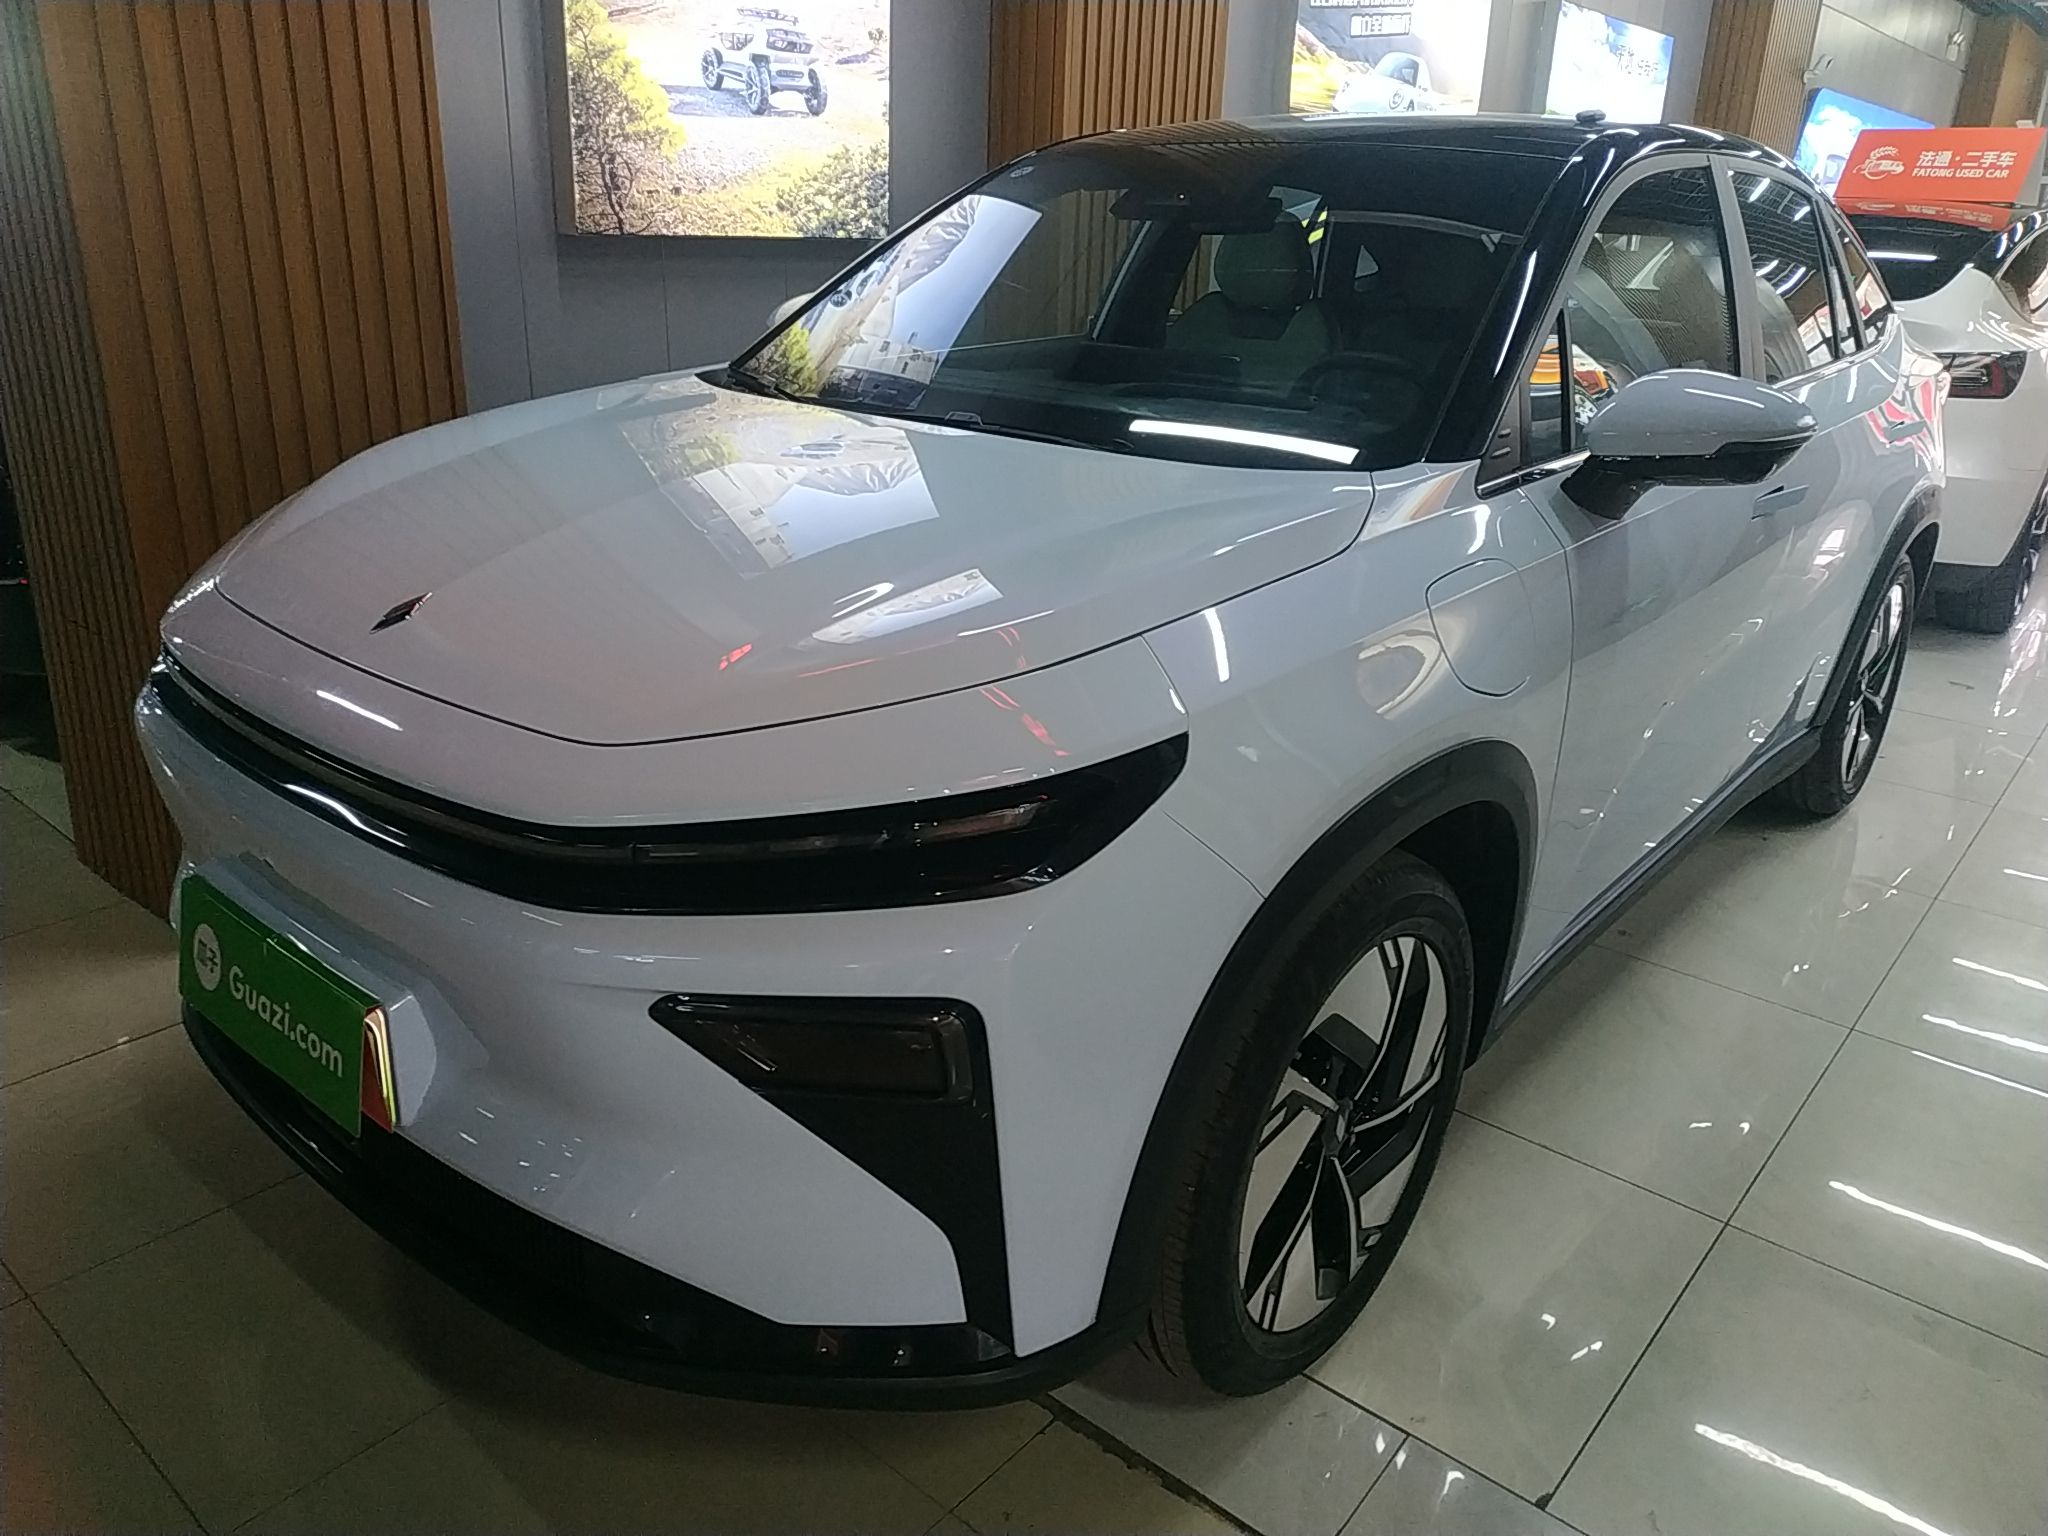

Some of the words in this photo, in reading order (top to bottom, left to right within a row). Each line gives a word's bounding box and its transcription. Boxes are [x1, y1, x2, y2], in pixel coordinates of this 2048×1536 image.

[1916, 150, 2018, 168] 法通·二手车
[1911, 168, 1955, 177] FATONG
[1955, 168, 1984, 178] USED
[1985, 169, 2010, 179] CAR
[229, 965, 343, 1078] Guazi.com
